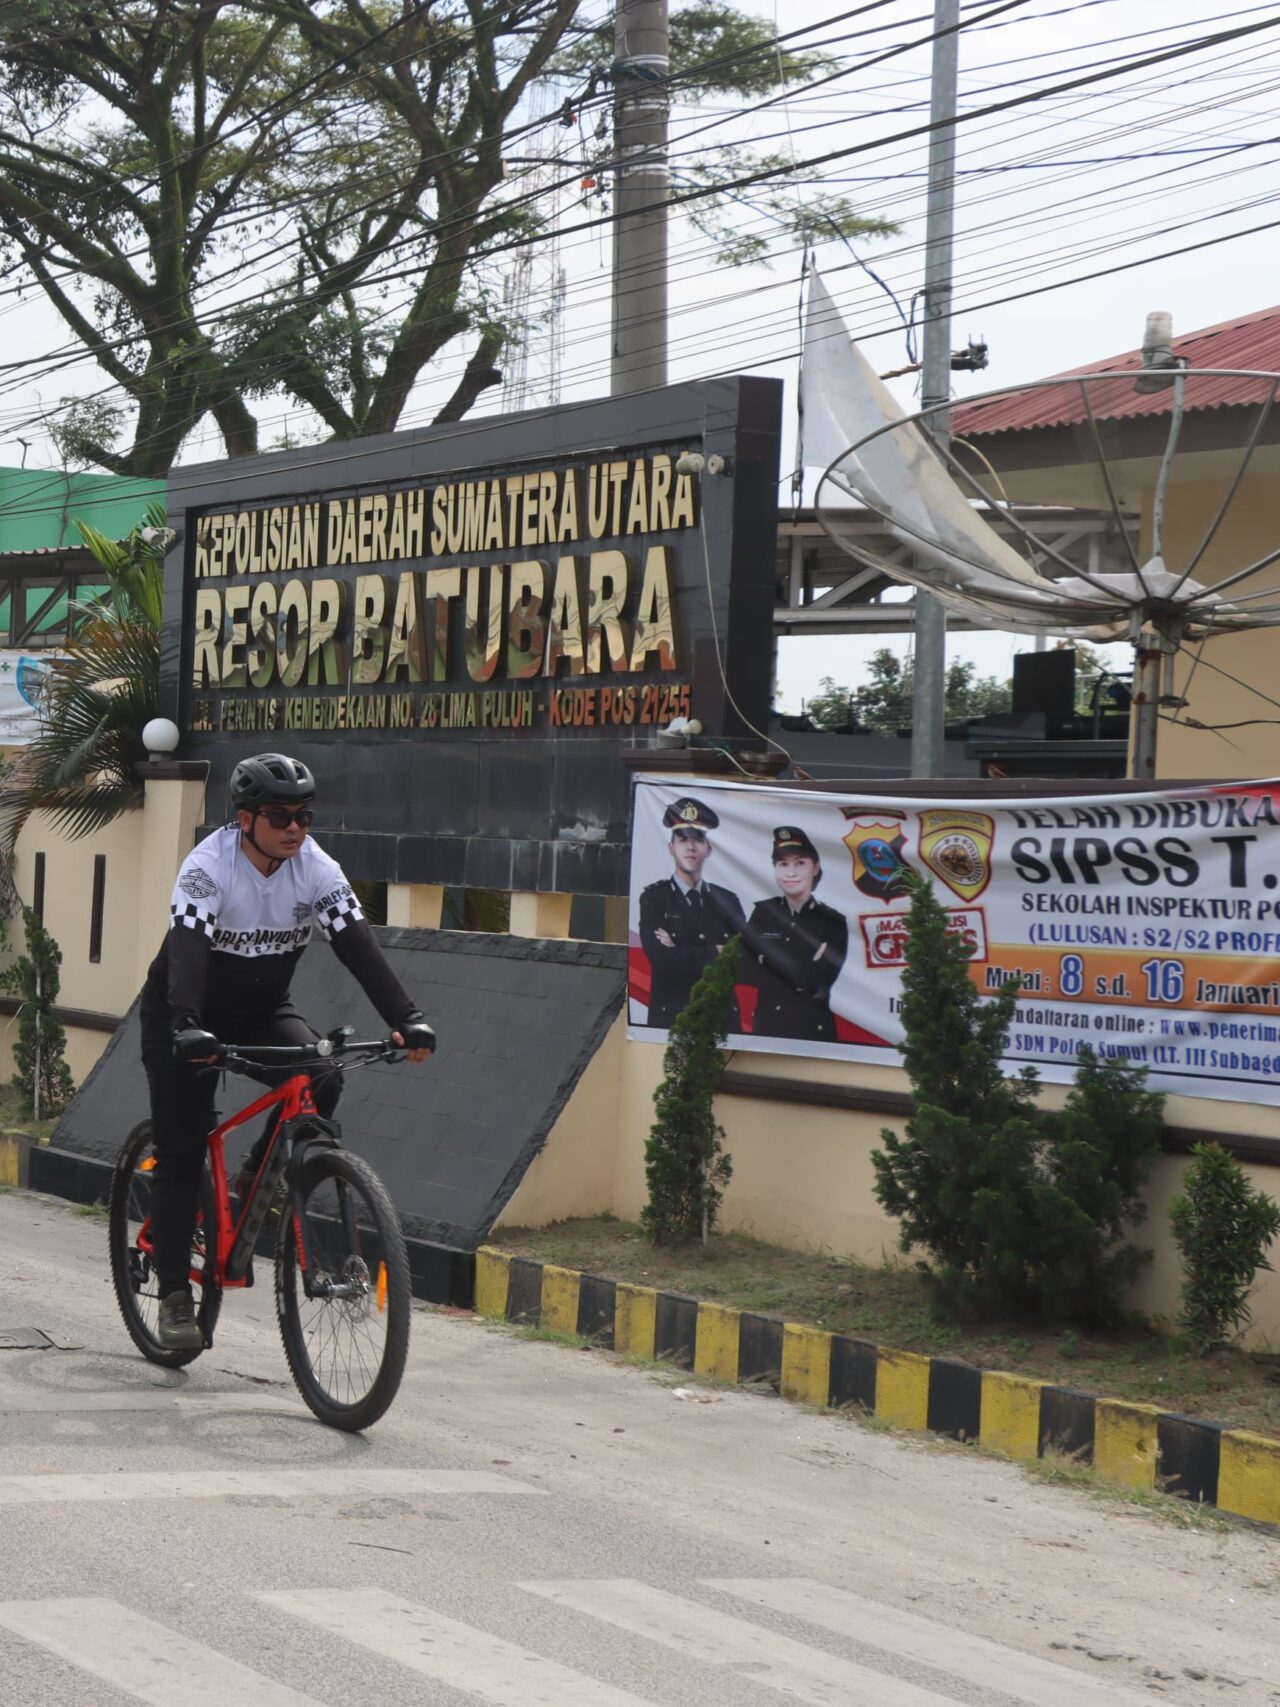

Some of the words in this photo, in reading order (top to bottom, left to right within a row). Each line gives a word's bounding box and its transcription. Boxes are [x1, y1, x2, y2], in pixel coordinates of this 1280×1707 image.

[195, 503, 319, 577] KEPOLISIAN
[327, 489, 424, 565] DAERAH
[431, 469, 578, 556] SUMATERA
[588, 451, 695, 539] UTARA
[194, 578, 343, 688] RESOR
[221, 697, 277, 730] PERINTIS
[284, 694, 386, 729] KEMERDEKAAN
[390, 693, 414, 728] NO.
[420, 693, 437, 727] 28
[440, 692, 476, 728] LIMA
[482, 690, 534, 728] PULUH
[550, 688, 595, 726] KODE
[600, 686, 636, 725] POS
[640, 684, 691, 724] 21255
[998, 805, 1121, 829] TELAH
[1125, 796, 1280, 829] DIBUKA
[1010, 836, 1200, 887] SIPSS
[1022, 893, 1121, 915] SEKOLAH
[1127, 896, 1253, 920] INSPEKTUR
[1028, 923, 1128, 945] (LULUSAN
[1144, 928, 1210, 951] S2/S2
[985, 966, 1041, 992] Mulai
[1061, 955, 1082, 995] 8
[1095, 974, 1131, 997] s.d.
[1142, 960, 1183, 1001] 16
[1194, 978, 1280, 1006] Januari
[1015, 1008, 1090, 1029] ndaftaran
[1094, 1013, 1144, 1034] online
[1160, 1018, 1280, 1043] www.penerim
[1015, 1033, 1045, 1053] SDM
[1049, 1036, 1094, 1055] Polda
[1153, 1045, 1181, 1065] (LT.
[1185, 1046, 1206, 1067] III
